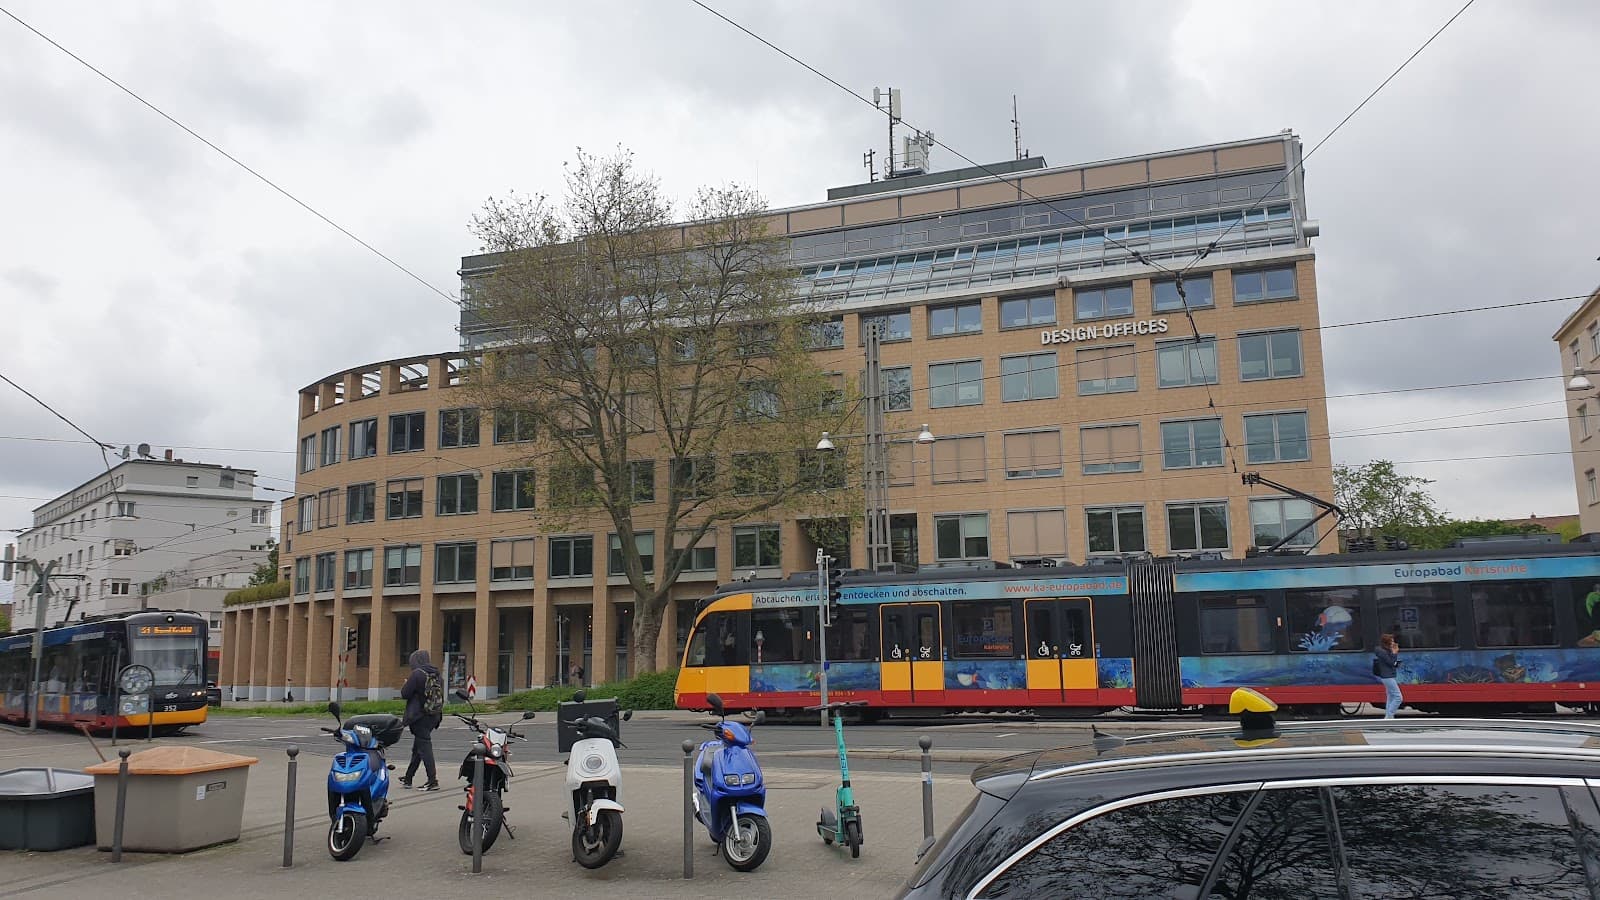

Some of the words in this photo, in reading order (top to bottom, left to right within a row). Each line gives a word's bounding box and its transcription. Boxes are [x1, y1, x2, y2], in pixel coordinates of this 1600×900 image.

[1041, 325, 1097, 345] DESIGN
[1103, 318, 1168, 338] OFFICES
[1394, 566, 1461, 578] Europabad
[1464, 563, 1527, 576] Karlsruhe
[843, 590, 890, 600] entdecken
[892, 588, 910, 598] und
[912, 587, 967, 597] abschalten.
[1004, 581, 1122, 593] www.ka-europabad.de
